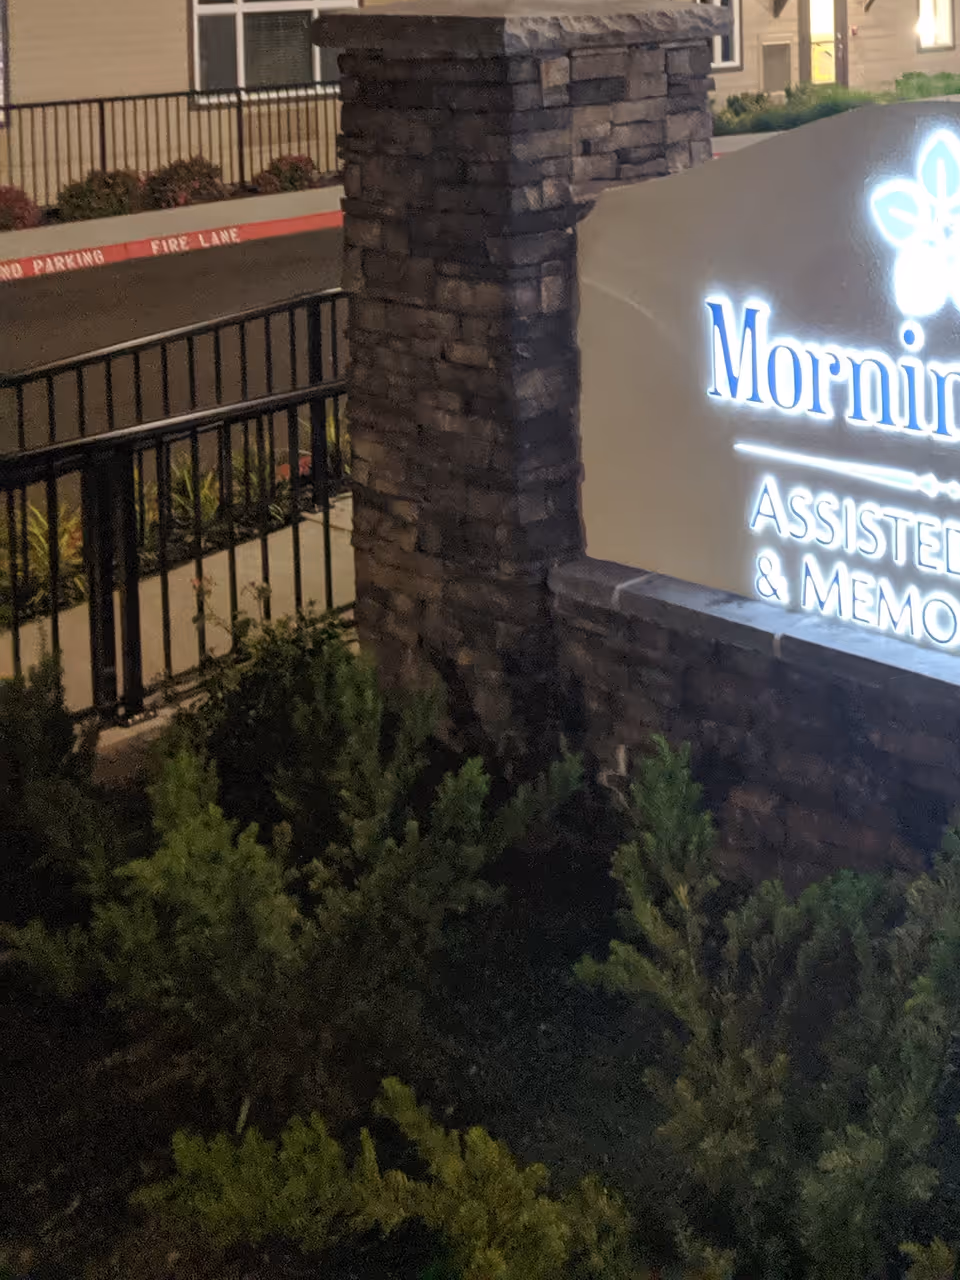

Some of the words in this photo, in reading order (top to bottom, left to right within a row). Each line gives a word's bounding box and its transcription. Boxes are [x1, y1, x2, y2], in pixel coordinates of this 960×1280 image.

[33, 250, 105, 274] PARKING
[150, 236, 190, 255] FIRE
[199, 228, 241, 248] LANE
[755, 552, 782, 601] &
